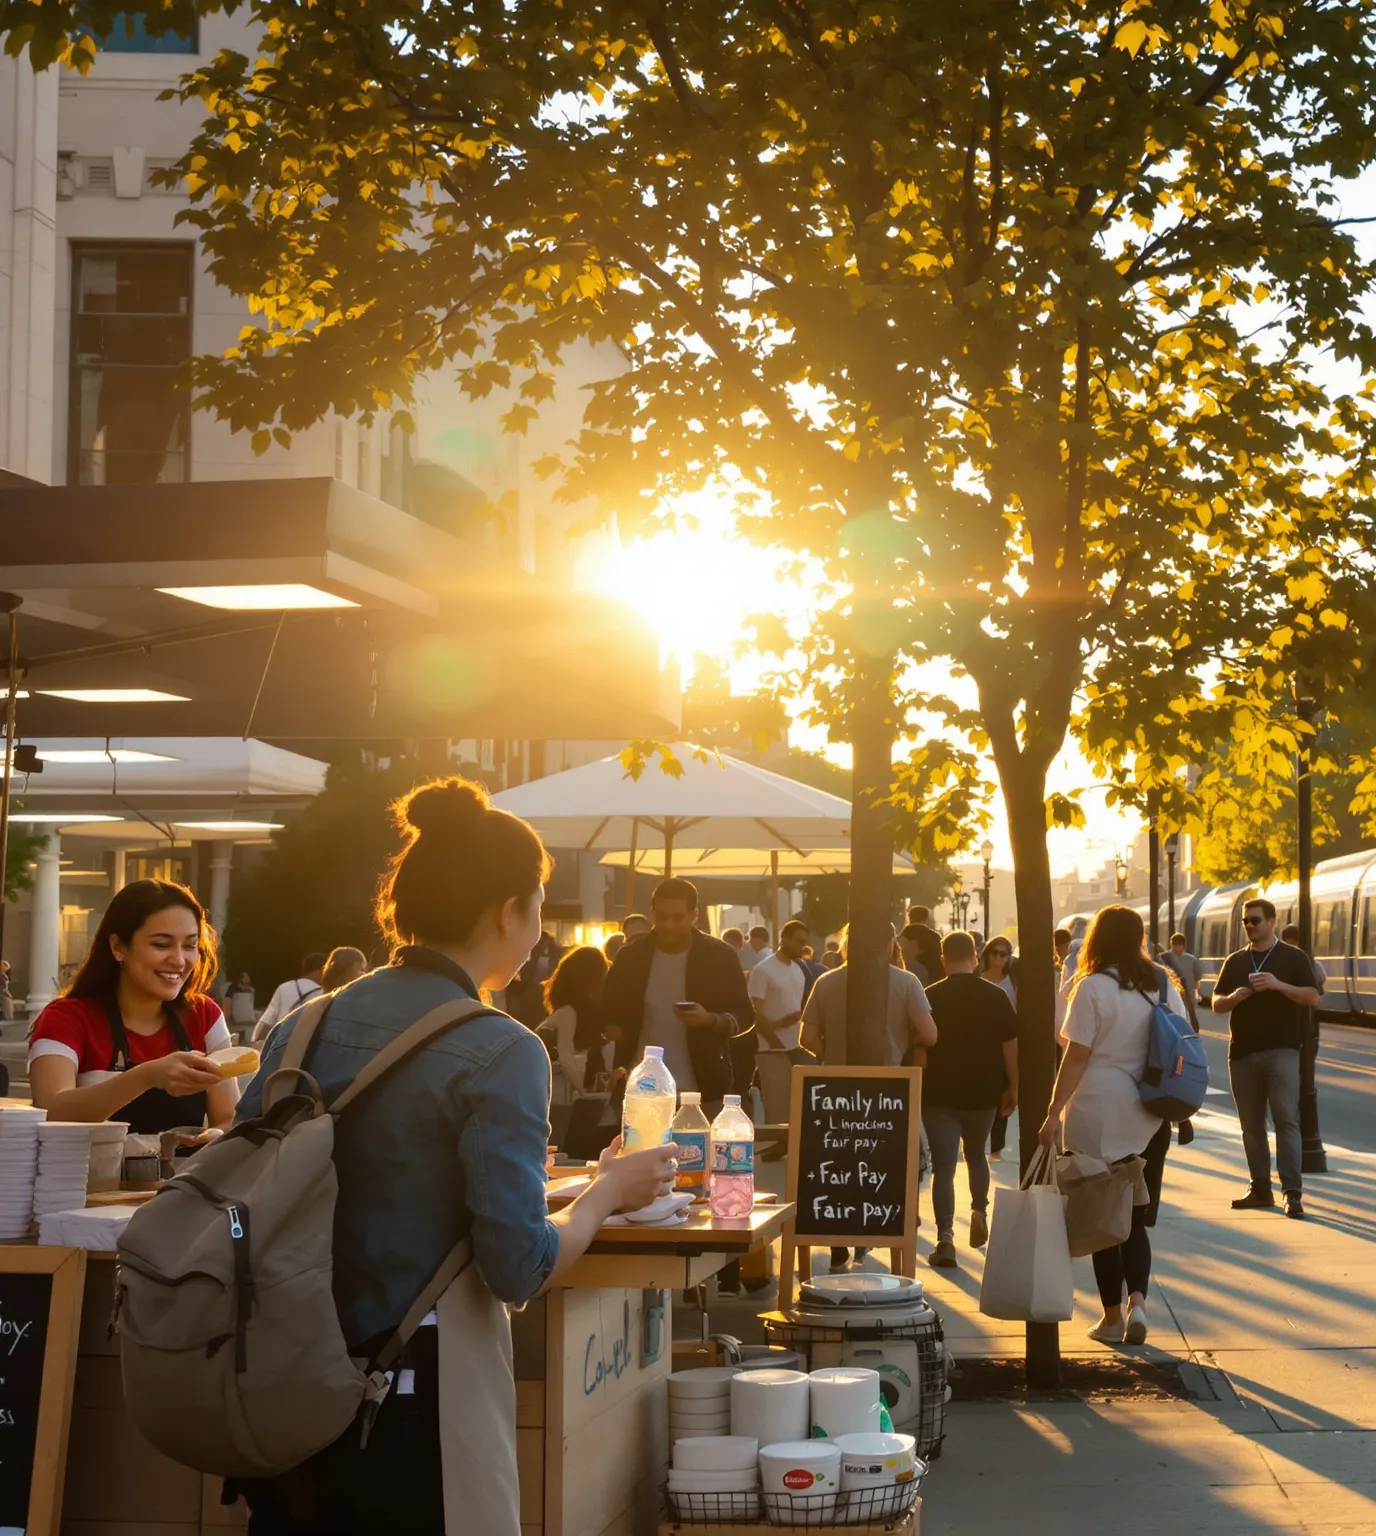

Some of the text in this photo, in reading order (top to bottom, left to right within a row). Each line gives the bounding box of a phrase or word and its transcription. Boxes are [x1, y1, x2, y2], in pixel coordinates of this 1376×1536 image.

[811, 1084, 872, 1118] Family
[820, 1160, 852, 1185] Fair
[858, 1161, 887, 1193] Pay
[812, 1195, 856, 1220] Fair
